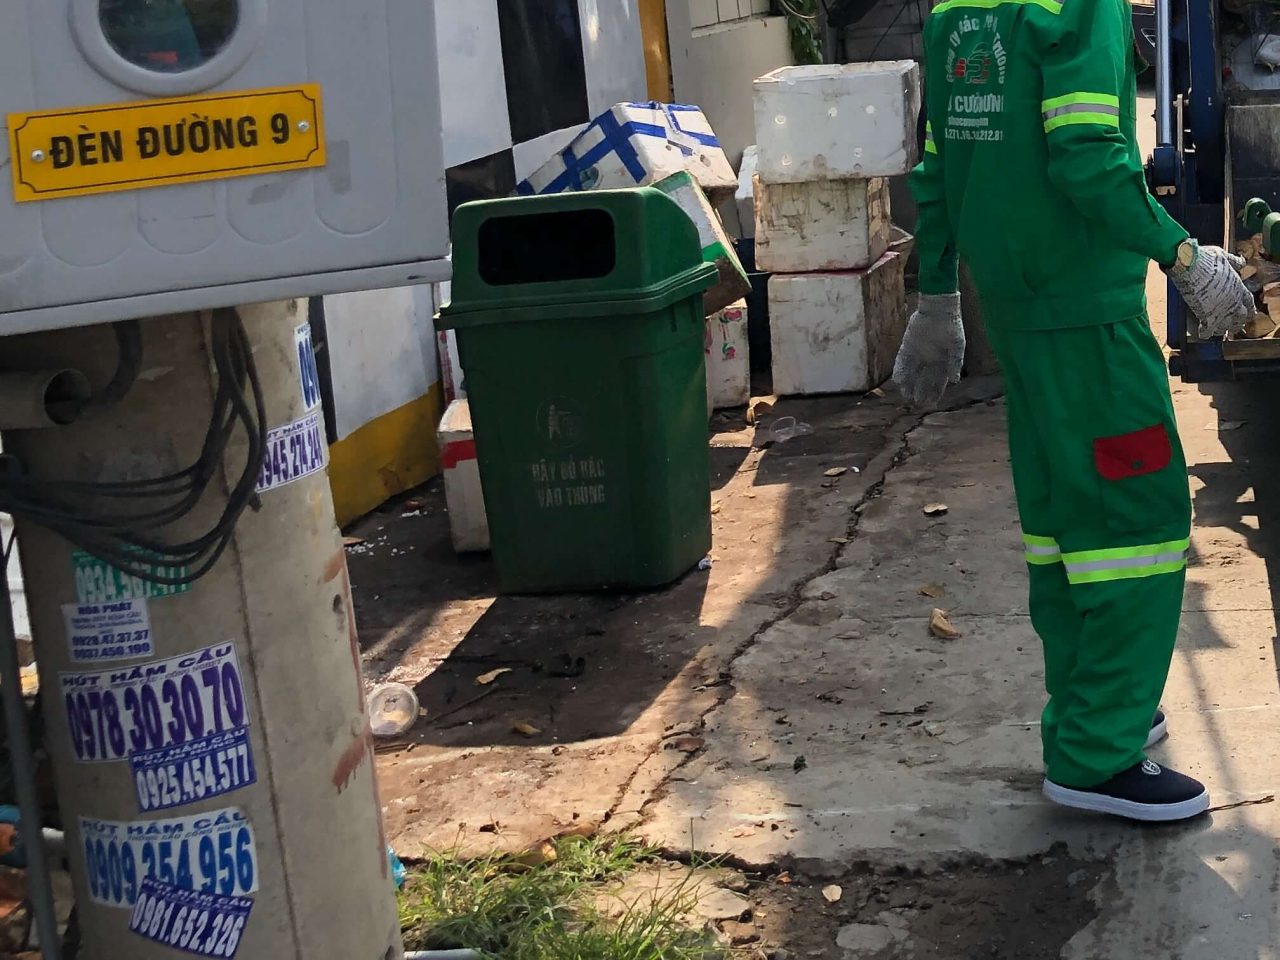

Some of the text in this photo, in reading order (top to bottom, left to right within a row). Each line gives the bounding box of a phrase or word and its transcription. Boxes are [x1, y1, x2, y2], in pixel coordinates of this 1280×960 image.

[49, 112, 291, 170] ĐÈN ĐƯỜNG 9
[136, 743, 250, 810] 0925.454.577
[130, 893, 246, 957] 0981.652.326
